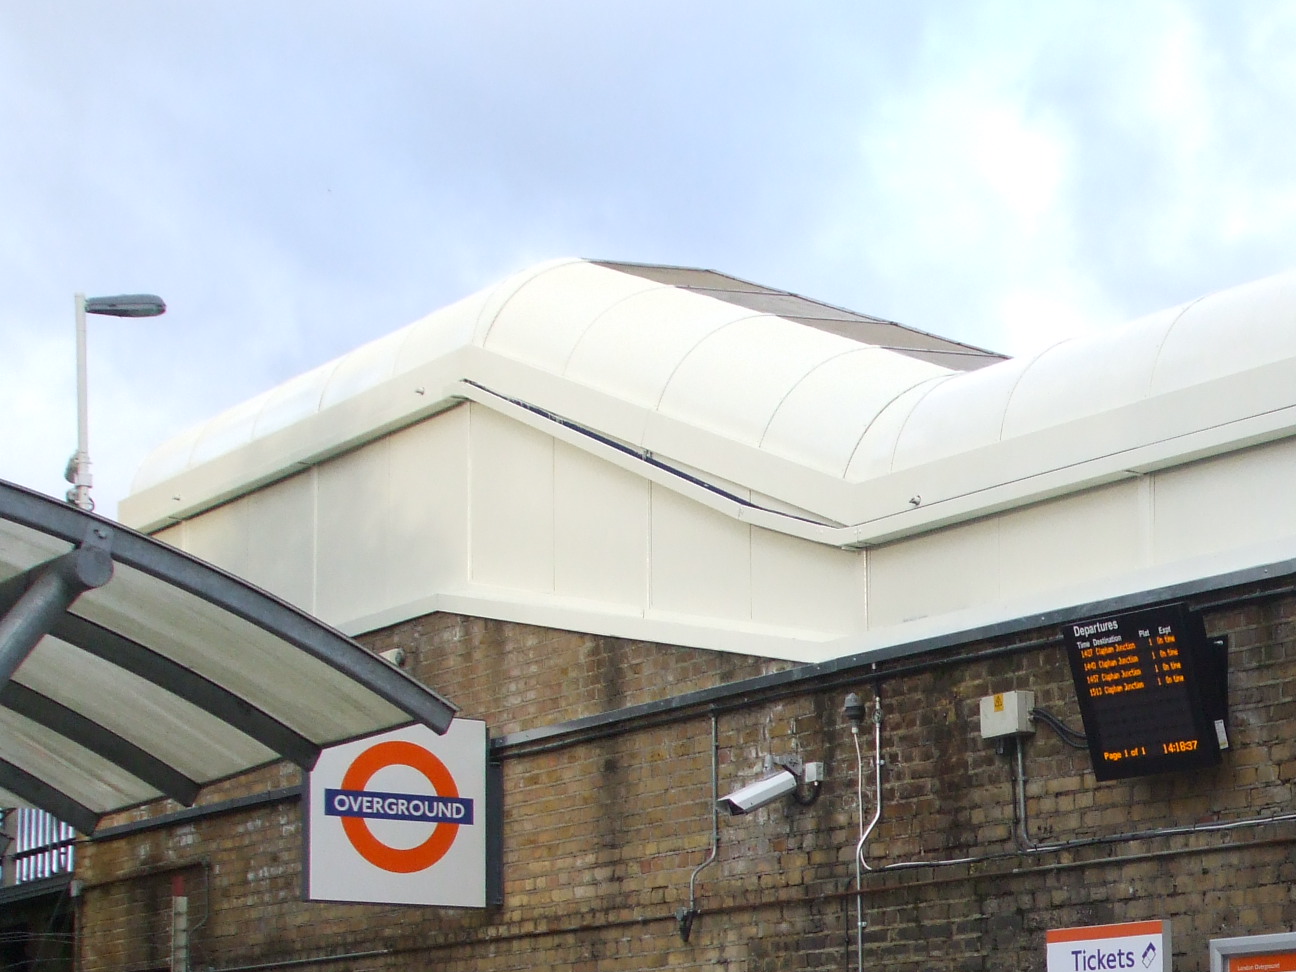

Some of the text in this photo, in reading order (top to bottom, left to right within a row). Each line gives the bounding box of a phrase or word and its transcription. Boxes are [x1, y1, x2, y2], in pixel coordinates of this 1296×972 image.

[1073, 620, 1118, 638] Departures
[1077, 641, 1090, 649] Time
[1093, 635, 1122, 646] Destination
[1104, 752, 1122, 760] Page
[1124, 750, 1128, 758] 1
[1130, 748, 1138, 756] of
[1142, 746, 1146, 754] 1
[334, 794, 465, 818] OVERGROUND
[1071, 948, 1135, 972] Tickets
